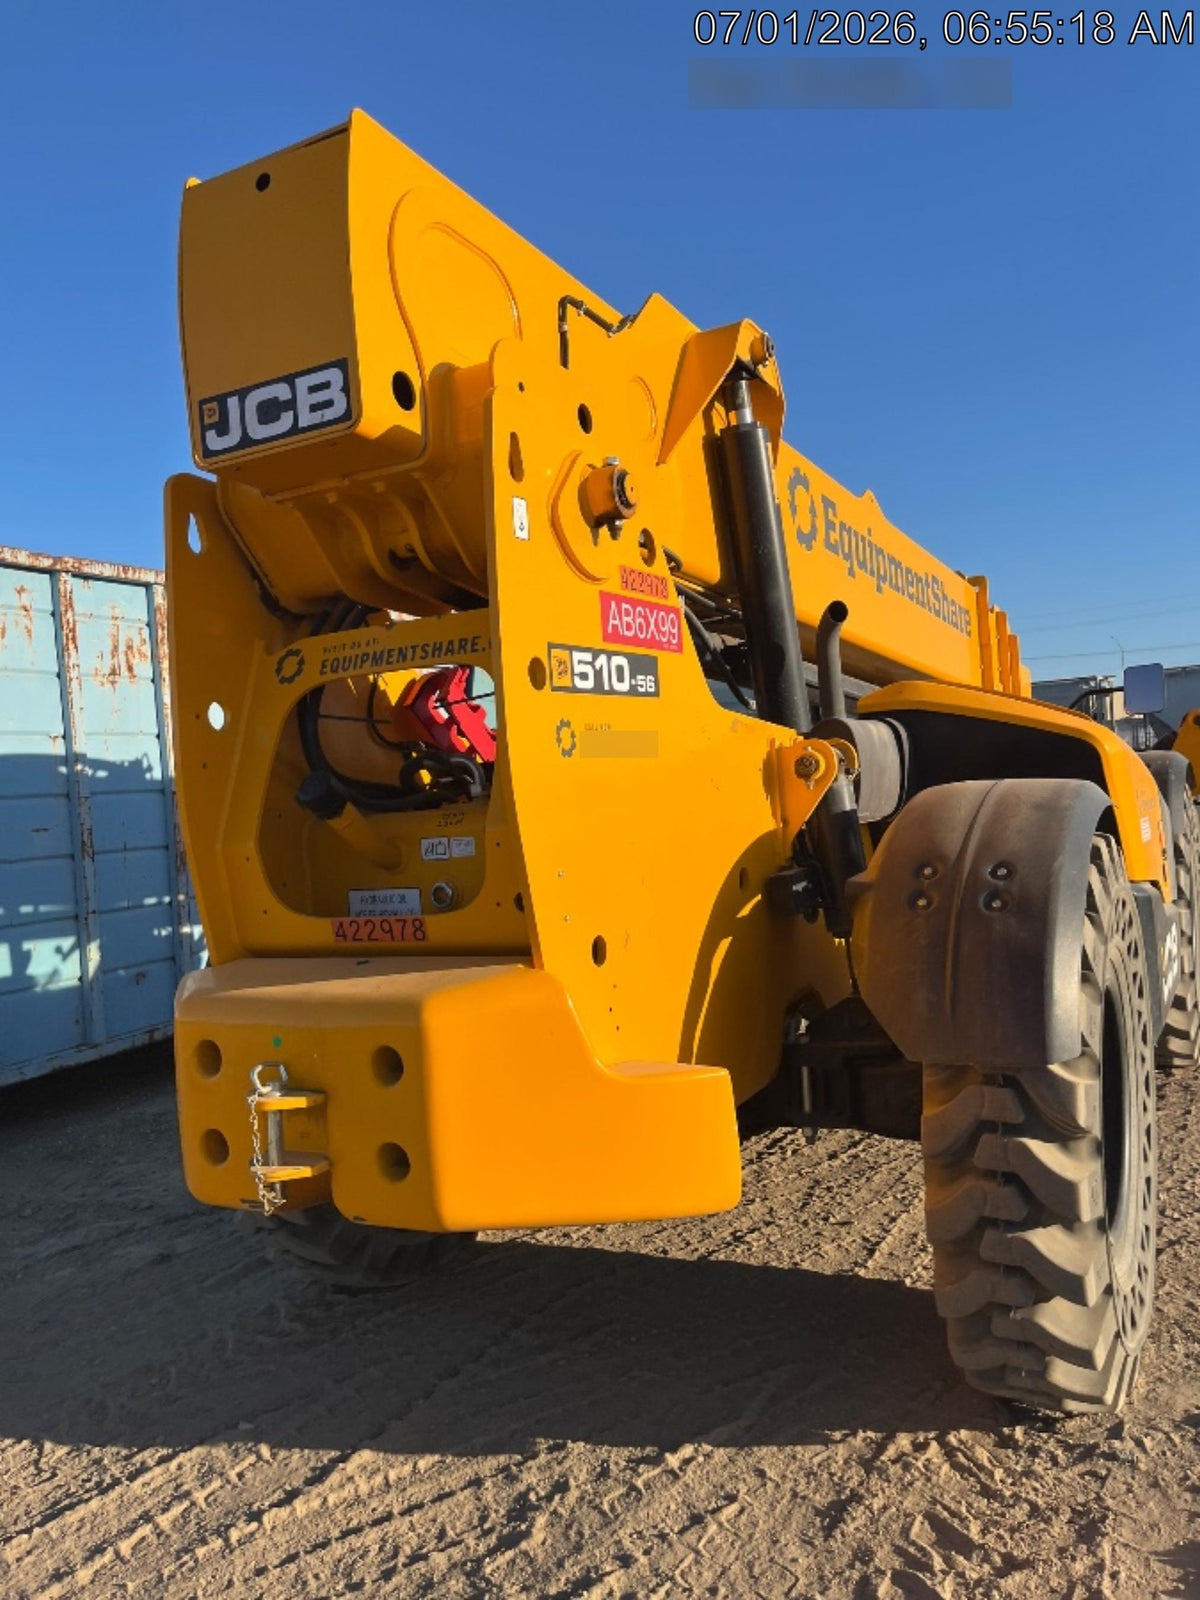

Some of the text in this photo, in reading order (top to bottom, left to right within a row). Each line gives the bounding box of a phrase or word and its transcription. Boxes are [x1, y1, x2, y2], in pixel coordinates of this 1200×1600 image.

[205, 367, 348, 451] JCB
[621, 568, 668, 599] 422978
[821, 494, 971, 638] EquipmentShare
[607, 600, 679, 644] AB6X99
[319, 636, 491, 676] EQUIPMENTSHARE.
[335, 918, 426, 941] 422978
